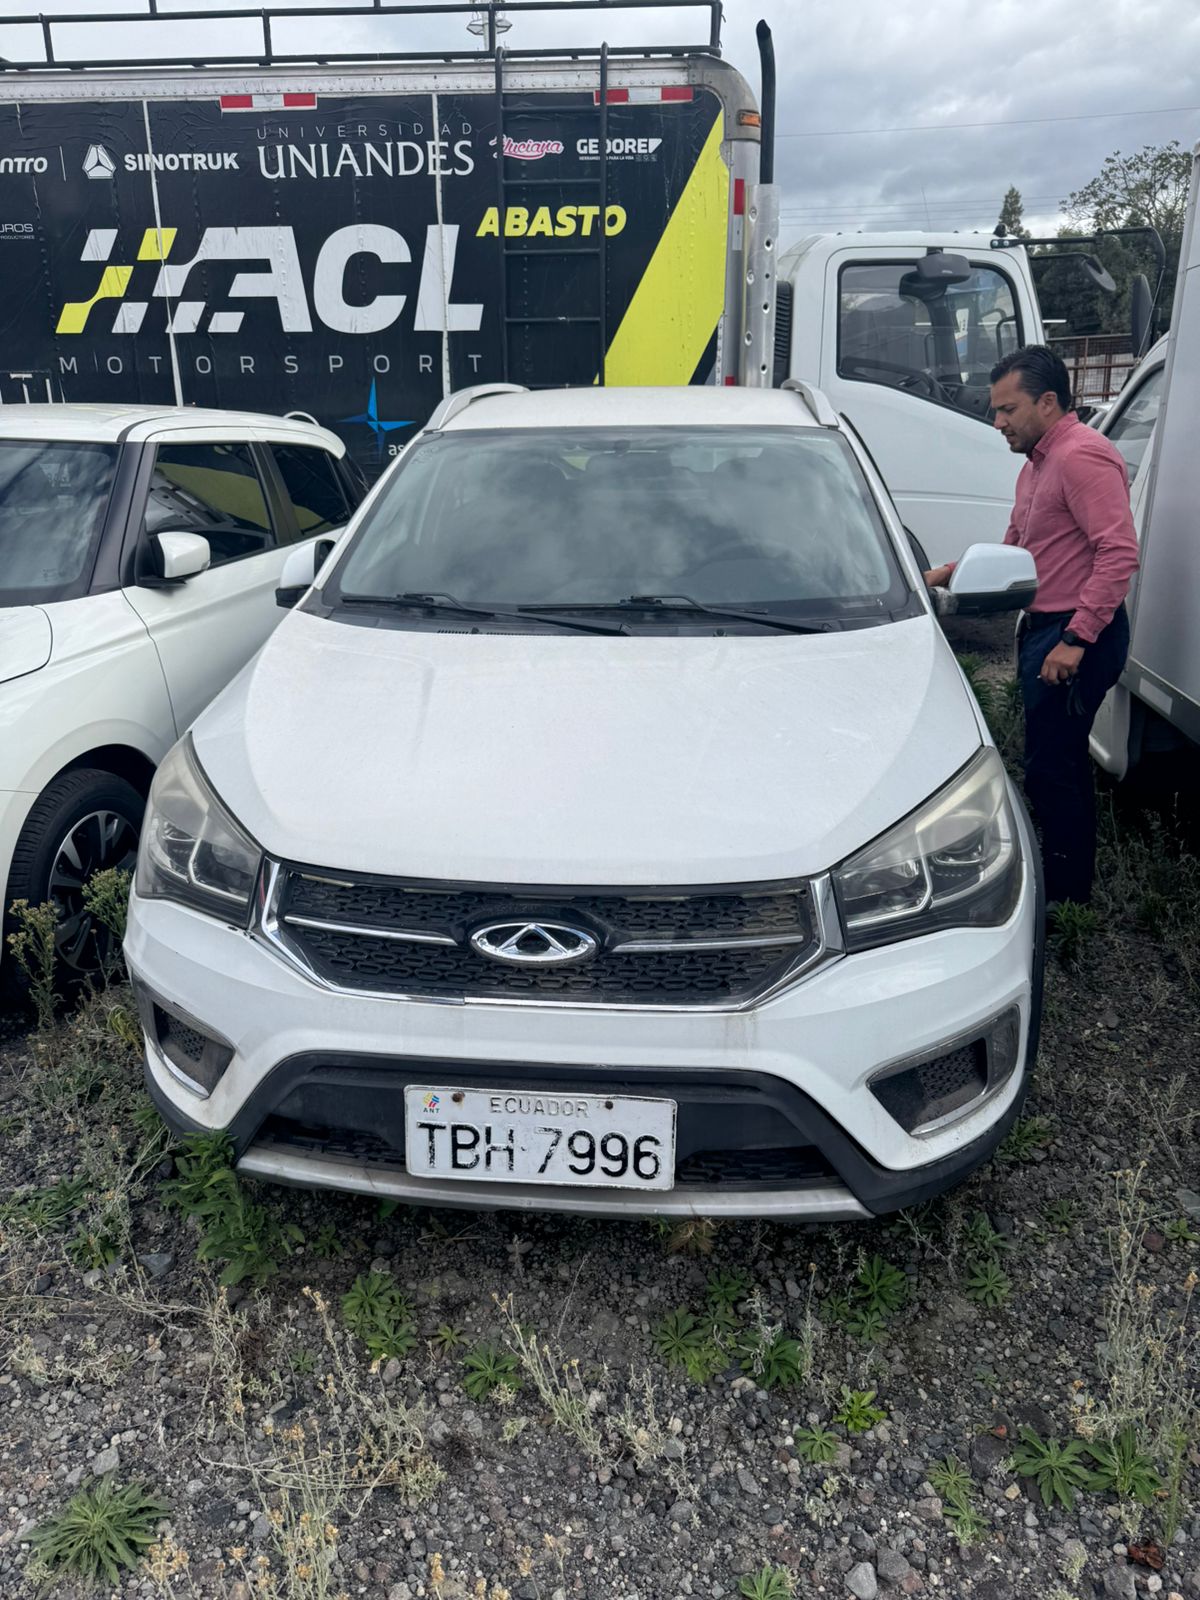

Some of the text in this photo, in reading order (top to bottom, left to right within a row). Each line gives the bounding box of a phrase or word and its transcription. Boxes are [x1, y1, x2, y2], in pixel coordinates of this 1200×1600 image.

[257, 123, 473, 140] UNIVERSIDAD
[124, 152, 240, 171] SINOTRUK
[257, 140, 475, 180] UNIANDES
[475, 204, 627, 237] ABASTO
[166, 223, 484, 334] ACL
[58, 354, 483, 375] MOTORSPORT
[489, 1096, 590, 1119] ECUADOR
